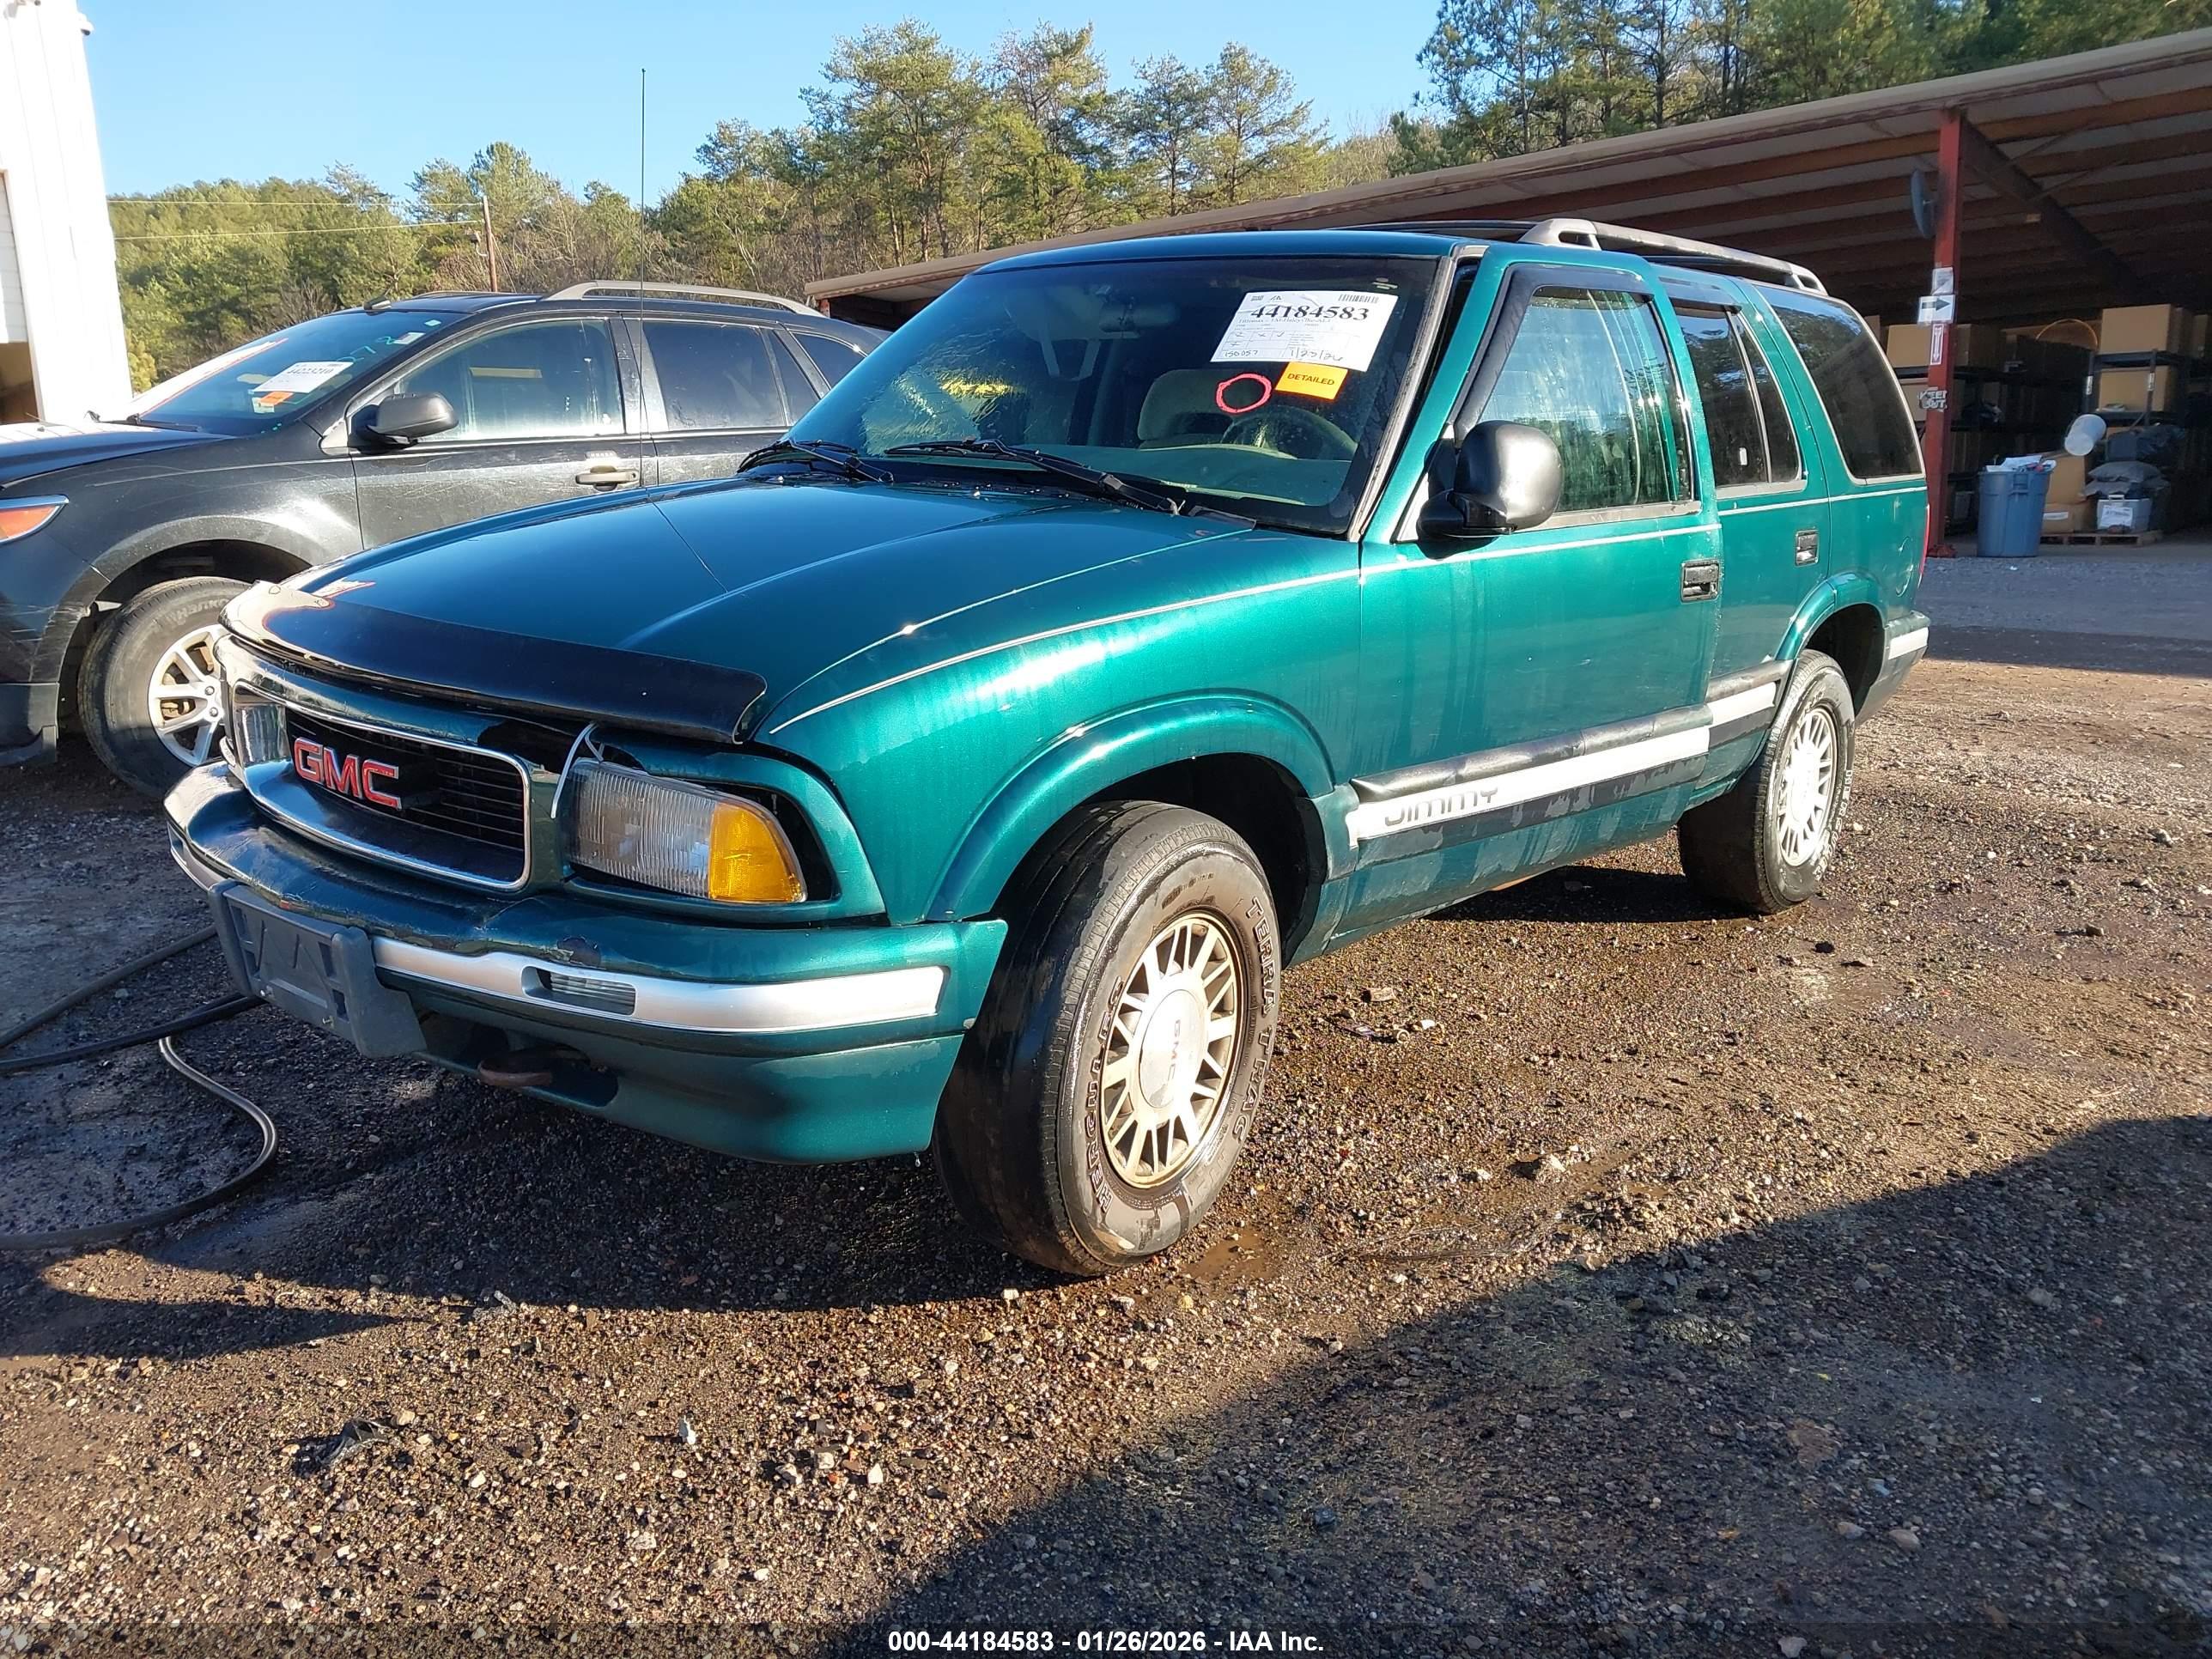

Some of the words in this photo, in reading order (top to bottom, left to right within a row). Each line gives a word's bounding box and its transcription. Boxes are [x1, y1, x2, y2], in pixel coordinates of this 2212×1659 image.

[1251, 305, 1369, 320] 44184583
[1287, 373, 1335, 386] DETAILED
[294, 737, 402, 810] GMC
[1245, 896, 1276, 1018] TERRA
[1085, 975, 1125, 1213] HERCULES
[1231, 1028, 1273, 1144] TRAC
